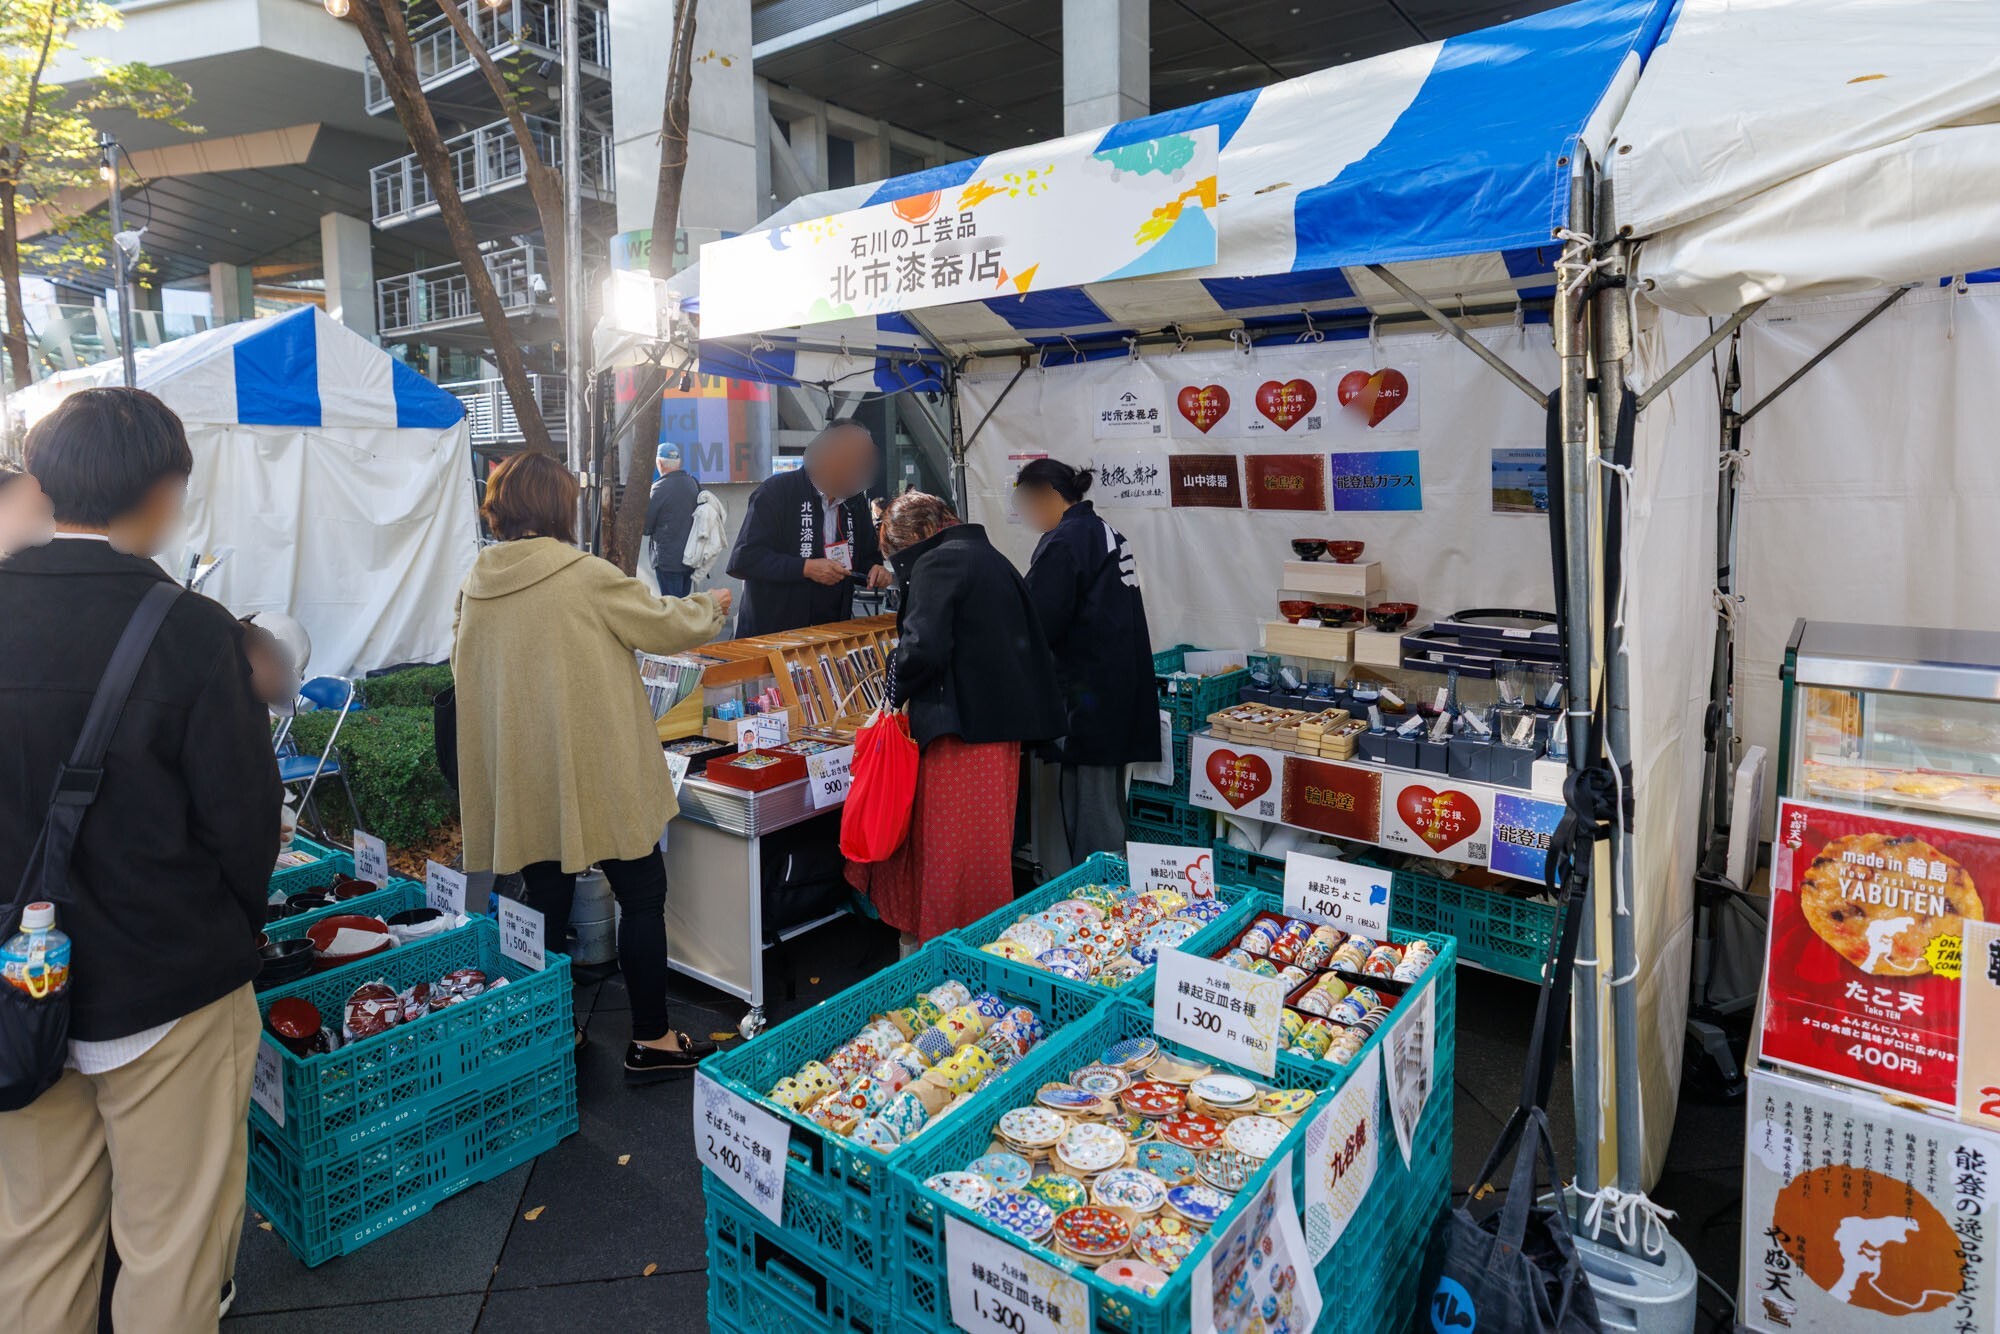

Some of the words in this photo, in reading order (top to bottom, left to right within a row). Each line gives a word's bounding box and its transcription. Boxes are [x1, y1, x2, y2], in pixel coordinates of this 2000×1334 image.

[850, 211, 977, 260] 石川の工芸品
[1183, 474, 1228, 488] 山中漆器
[1336, 474, 1416, 489] 能登島ガラス
[1219, 766, 1260, 782] 買って応援、
[1220, 778, 1255, 792] ありがとう
[824, 779, 842, 795] 900
[1305, 785, 1355, 811] 輪島塗
[1413, 804, 1467, 822] 買って応援、
[1416, 816, 1460, 832] ありがとう
[1150, 867, 1186, 880] 縁起小皿
[1839, 868, 1866, 881] New
[1842, 850, 1884, 870] made
[1888, 856, 1903, 873] in
[1907, 856, 1948, 884] 輪島
[1308, 881, 1361, 903] 縁起ちょこ
[1326, 875, 1347, 886] 九谷焼
[1302, 895, 1342, 918] 1,400
[1838, 877, 1945, 918] YABUTEN
[505, 931, 527, 953] 1,500
[1206, 977, 1231, 992] 九谷焼
[1177, 980, 1257, 1018] 縁起豆皿各種
[1845, 980, 1925, 1016] たこ天
[1176, 1001, 1222, 1034] 1,300
[1864, 1005, 1884, 1017] Tako
[1885, 1010, 1901, 1021] TEN
[1802, 1016, 1959, 1062] タコの食感と風味が口に広がりま
[1841, 1016, 1920, 1043] ふんだんに入った
[728, 1107, 746, 1126] 九谷焼
[705, 1109, 772, 1165] そばちょこ各種
[707, 1134, 741, 1174] 2,400
[1330, 1118, 1367, 1188] 九谷焼
[1953, 1145, 1988, 1334] 能登の逸品をどうぞ
[1001, 1261, 1029, 1285] 九谷焼
[971, 1261, 1062, 1324] 縁起豆皿各種
[973, 1288, 1026, 1334] 1,300
